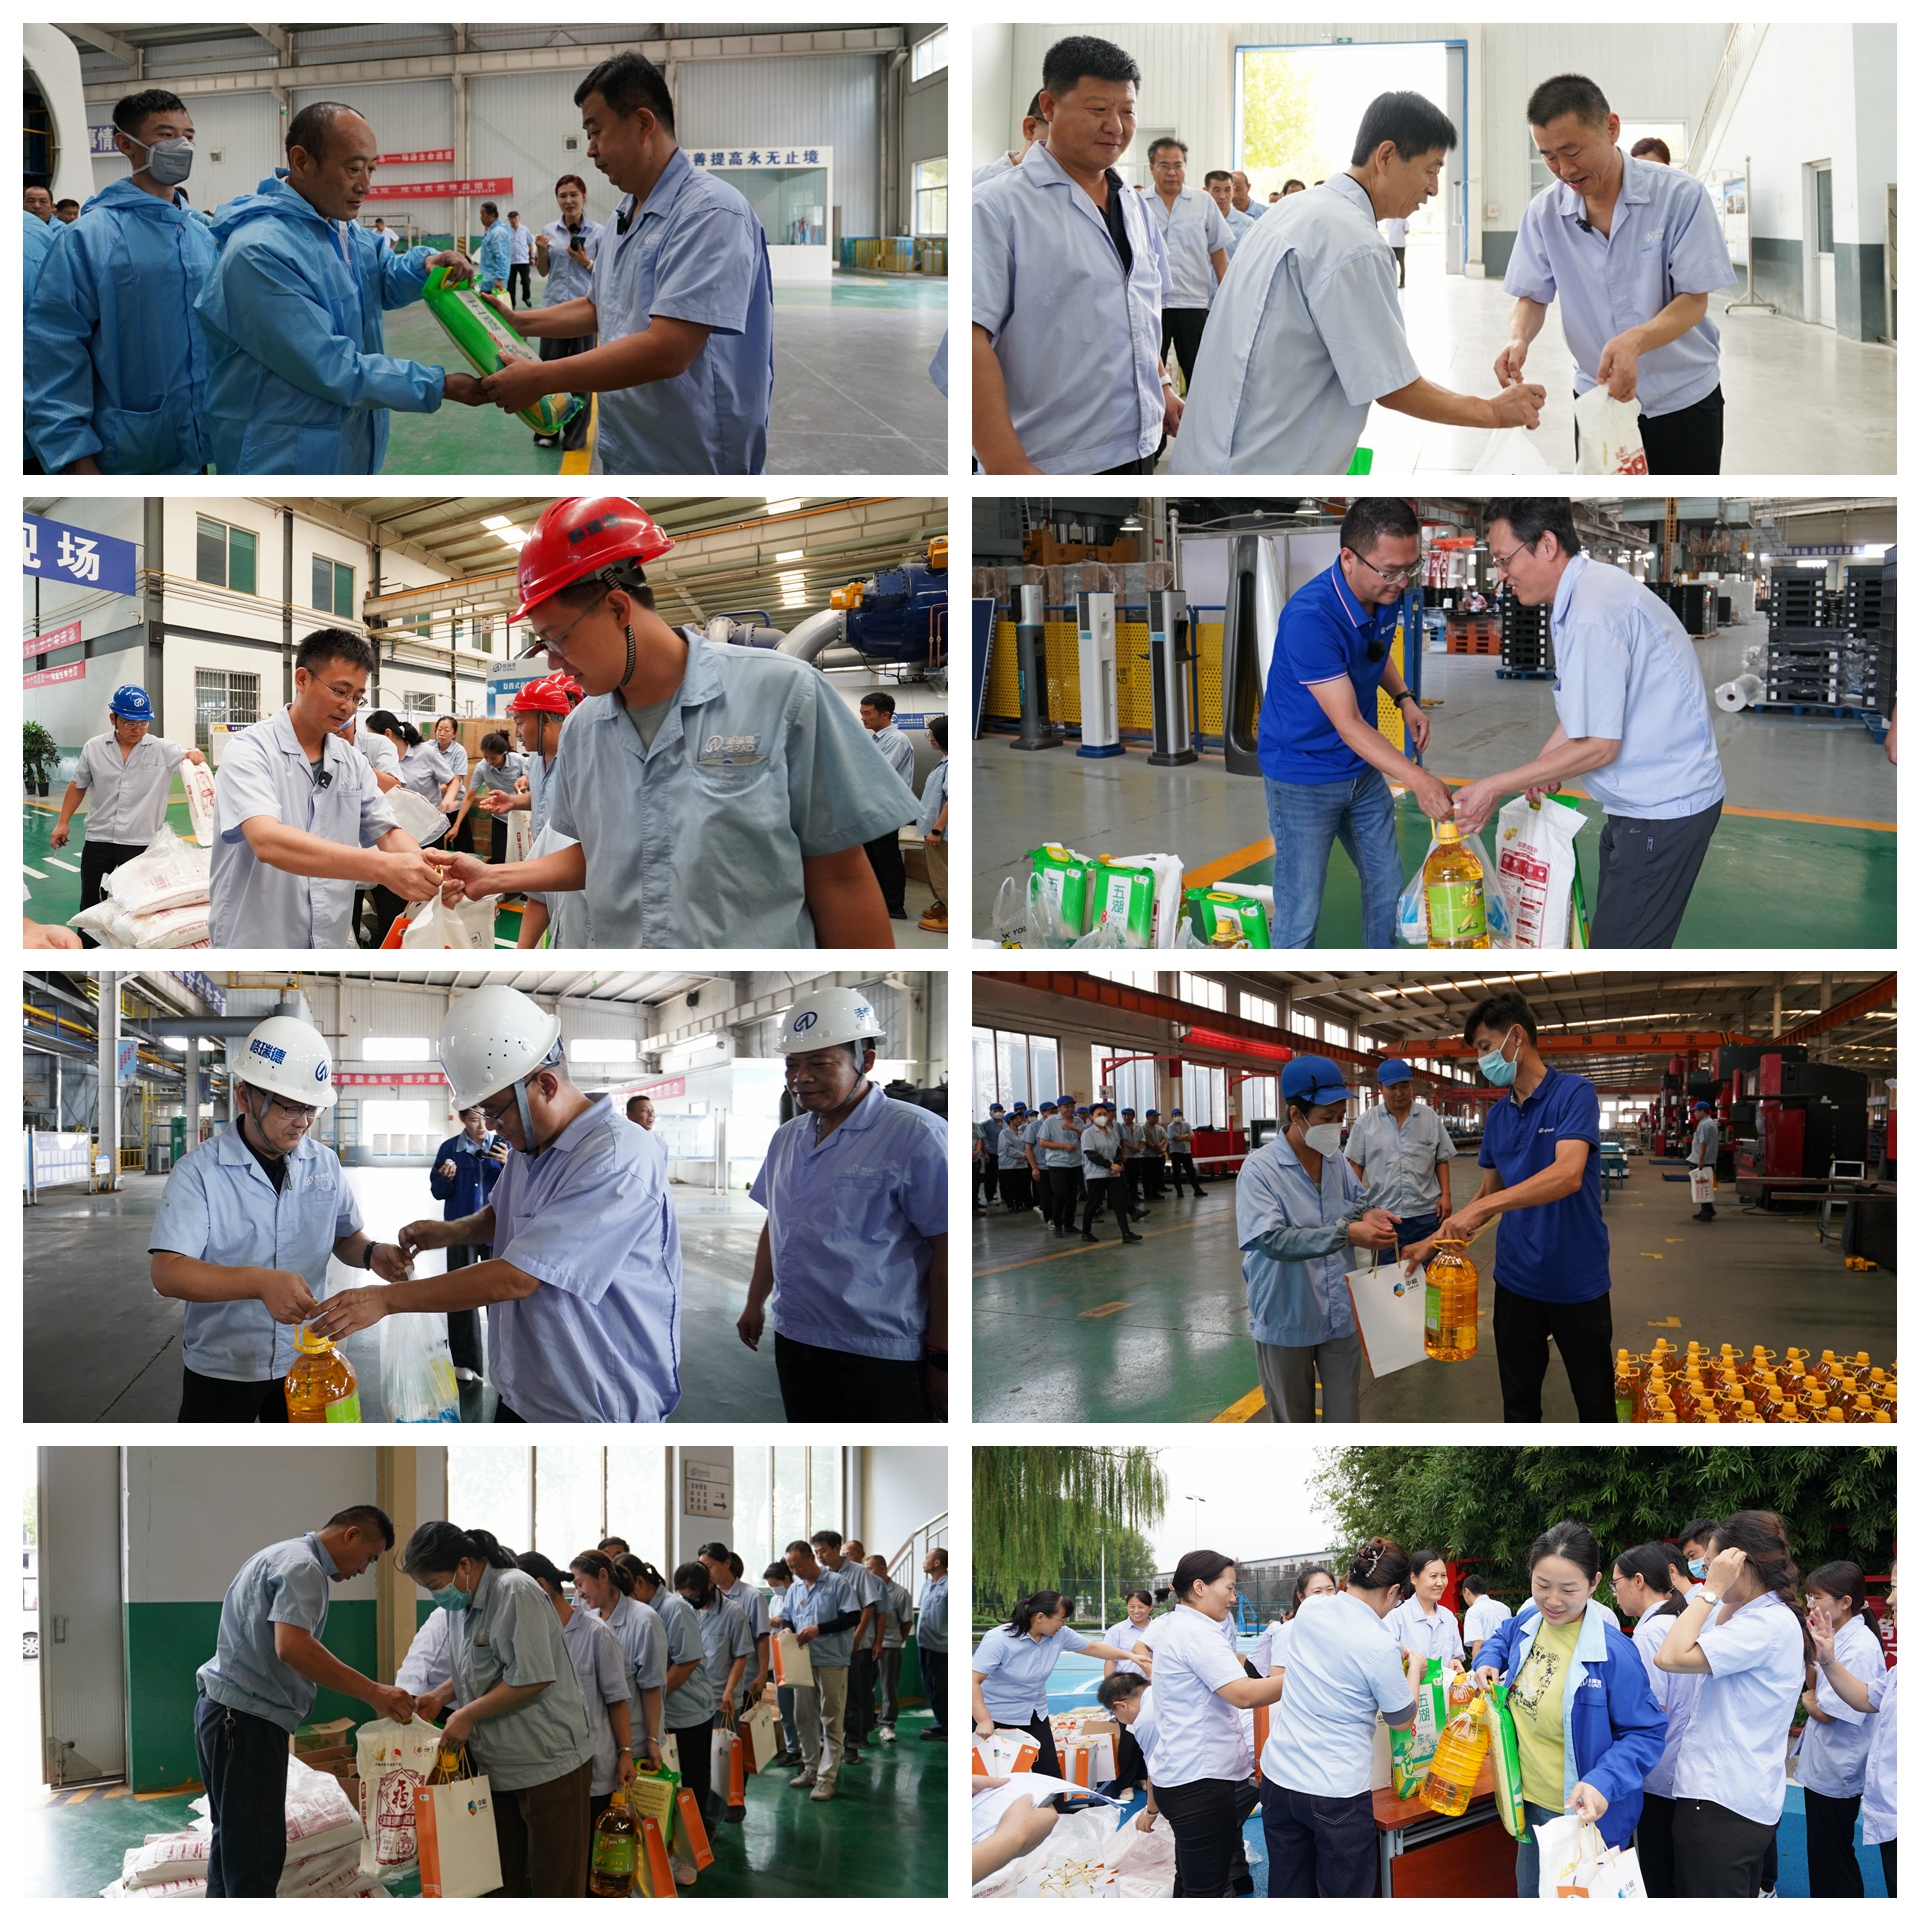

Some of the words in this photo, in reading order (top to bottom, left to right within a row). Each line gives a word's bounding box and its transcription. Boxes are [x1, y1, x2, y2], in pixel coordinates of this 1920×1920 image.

[687, 150, 820, 166] 善提高永无止境
[1111, 884, 1126, 914] 五湖
[249, 1038, 287, 1065] 格瑞德
[1418, 1693, 1430, 1723] 五湖
